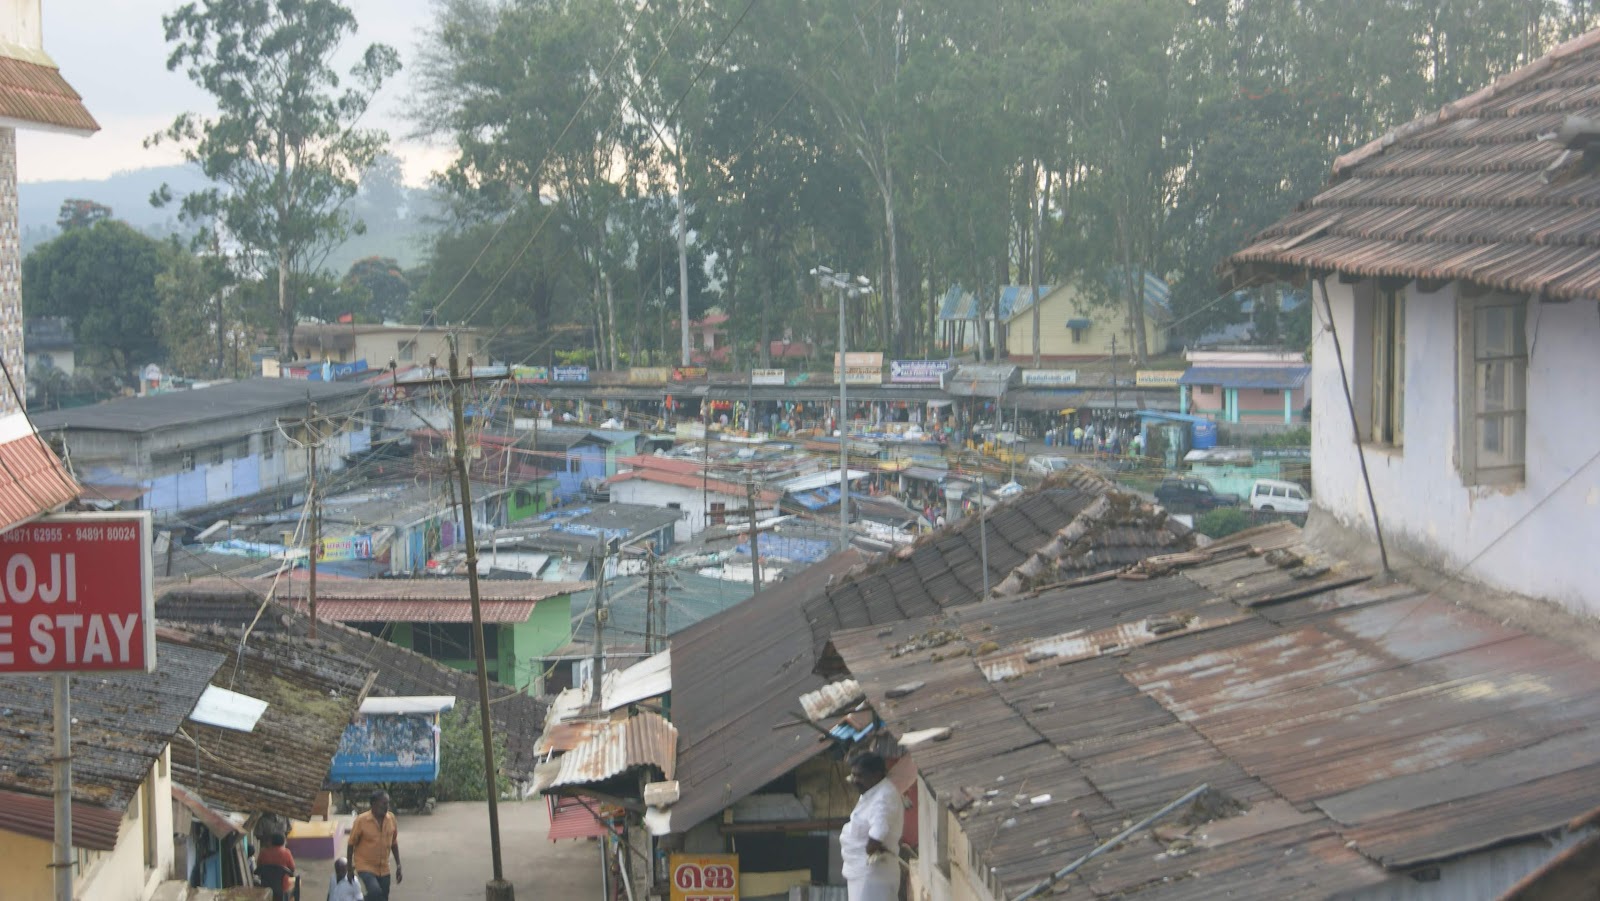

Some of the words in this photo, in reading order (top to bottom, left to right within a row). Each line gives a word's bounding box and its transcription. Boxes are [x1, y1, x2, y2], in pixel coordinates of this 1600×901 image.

[33, 528, 62, 542] 62955
[76, 527, 104, 541] 94891
[107, 527, 136, 541] 80024
[29, 613, 138, 664] STAY
